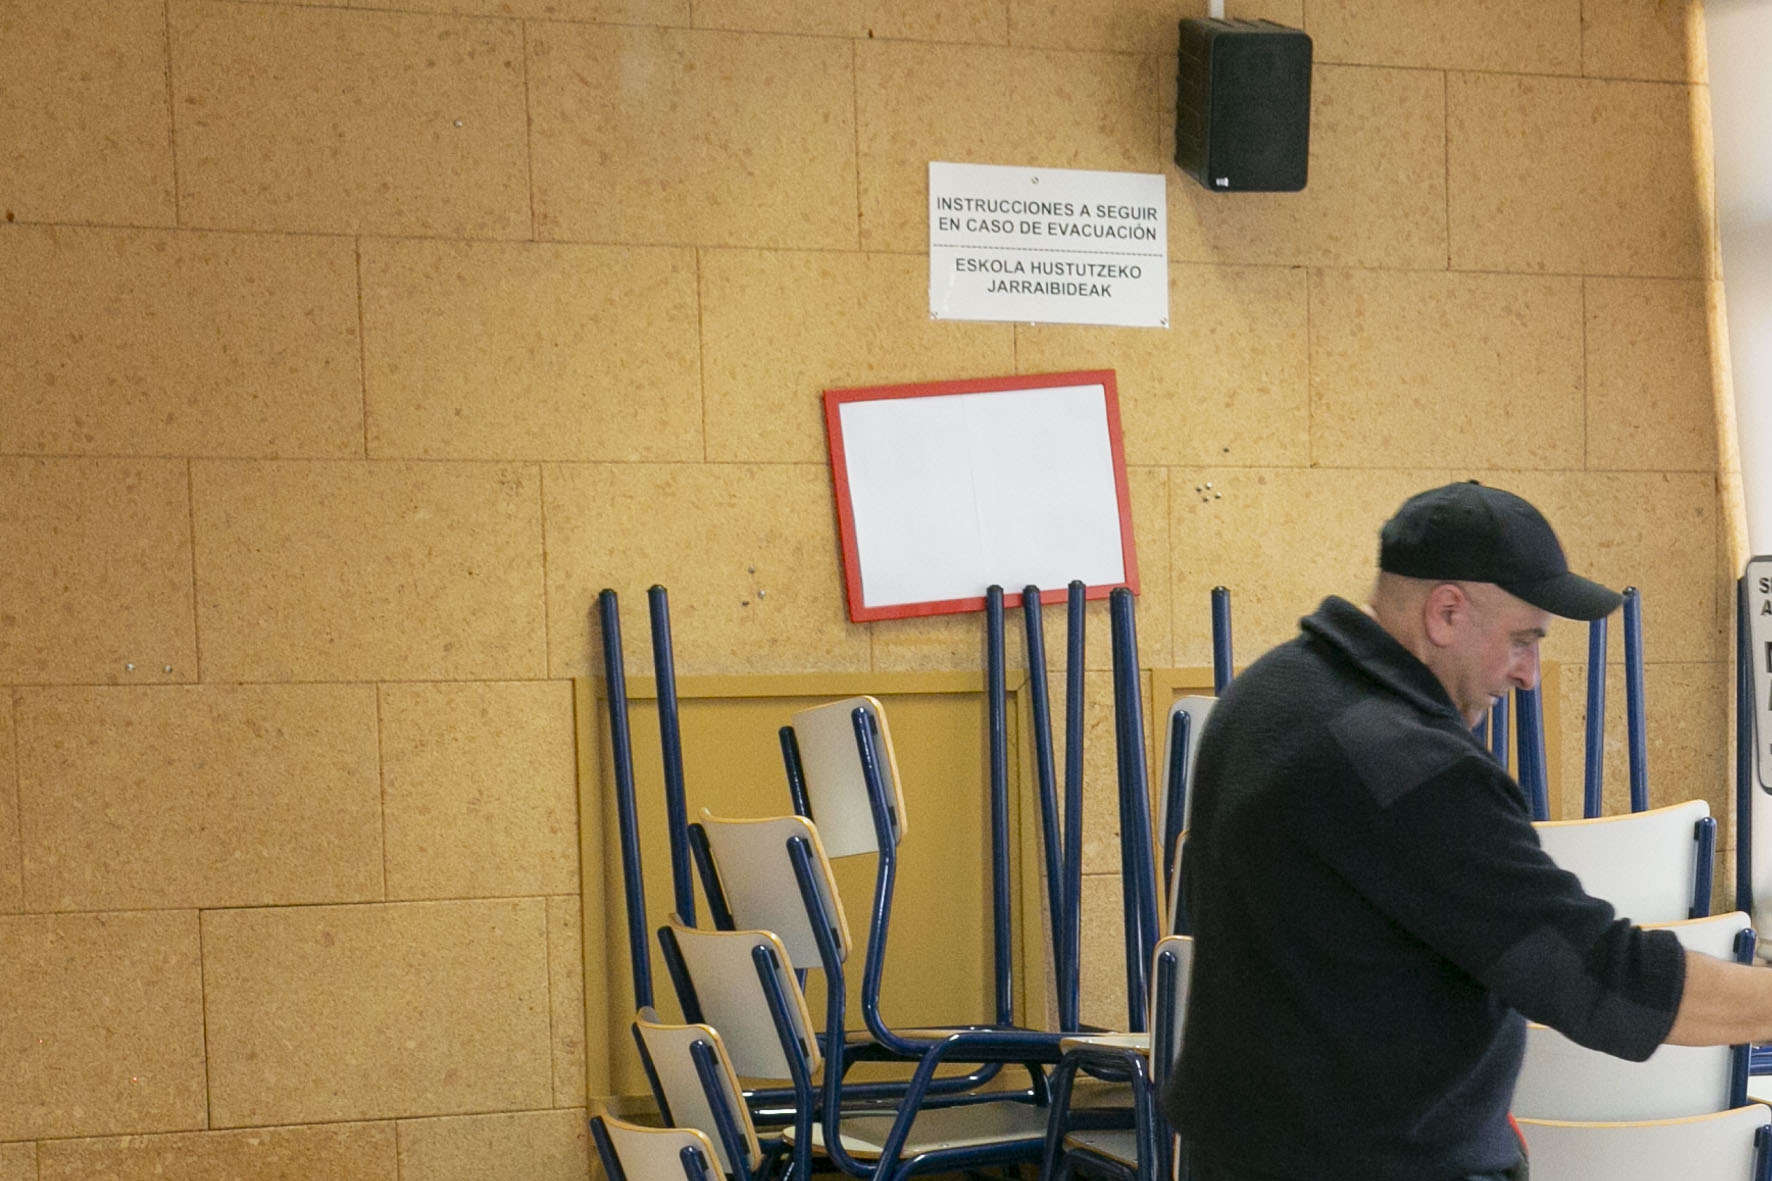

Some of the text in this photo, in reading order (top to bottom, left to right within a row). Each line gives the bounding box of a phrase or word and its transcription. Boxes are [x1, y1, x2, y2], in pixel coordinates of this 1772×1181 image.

[937, 197, 1158, 221] INSTRUCCIONES A SEGUIR
[939, 217, 1157, 240] EN CASO DE EVACUACIÓN
[956, 258, 1142, 279] ESKOLA HUSTUTZEKO
[987, 280, 1112, 297] JARRAIBIDEAK
